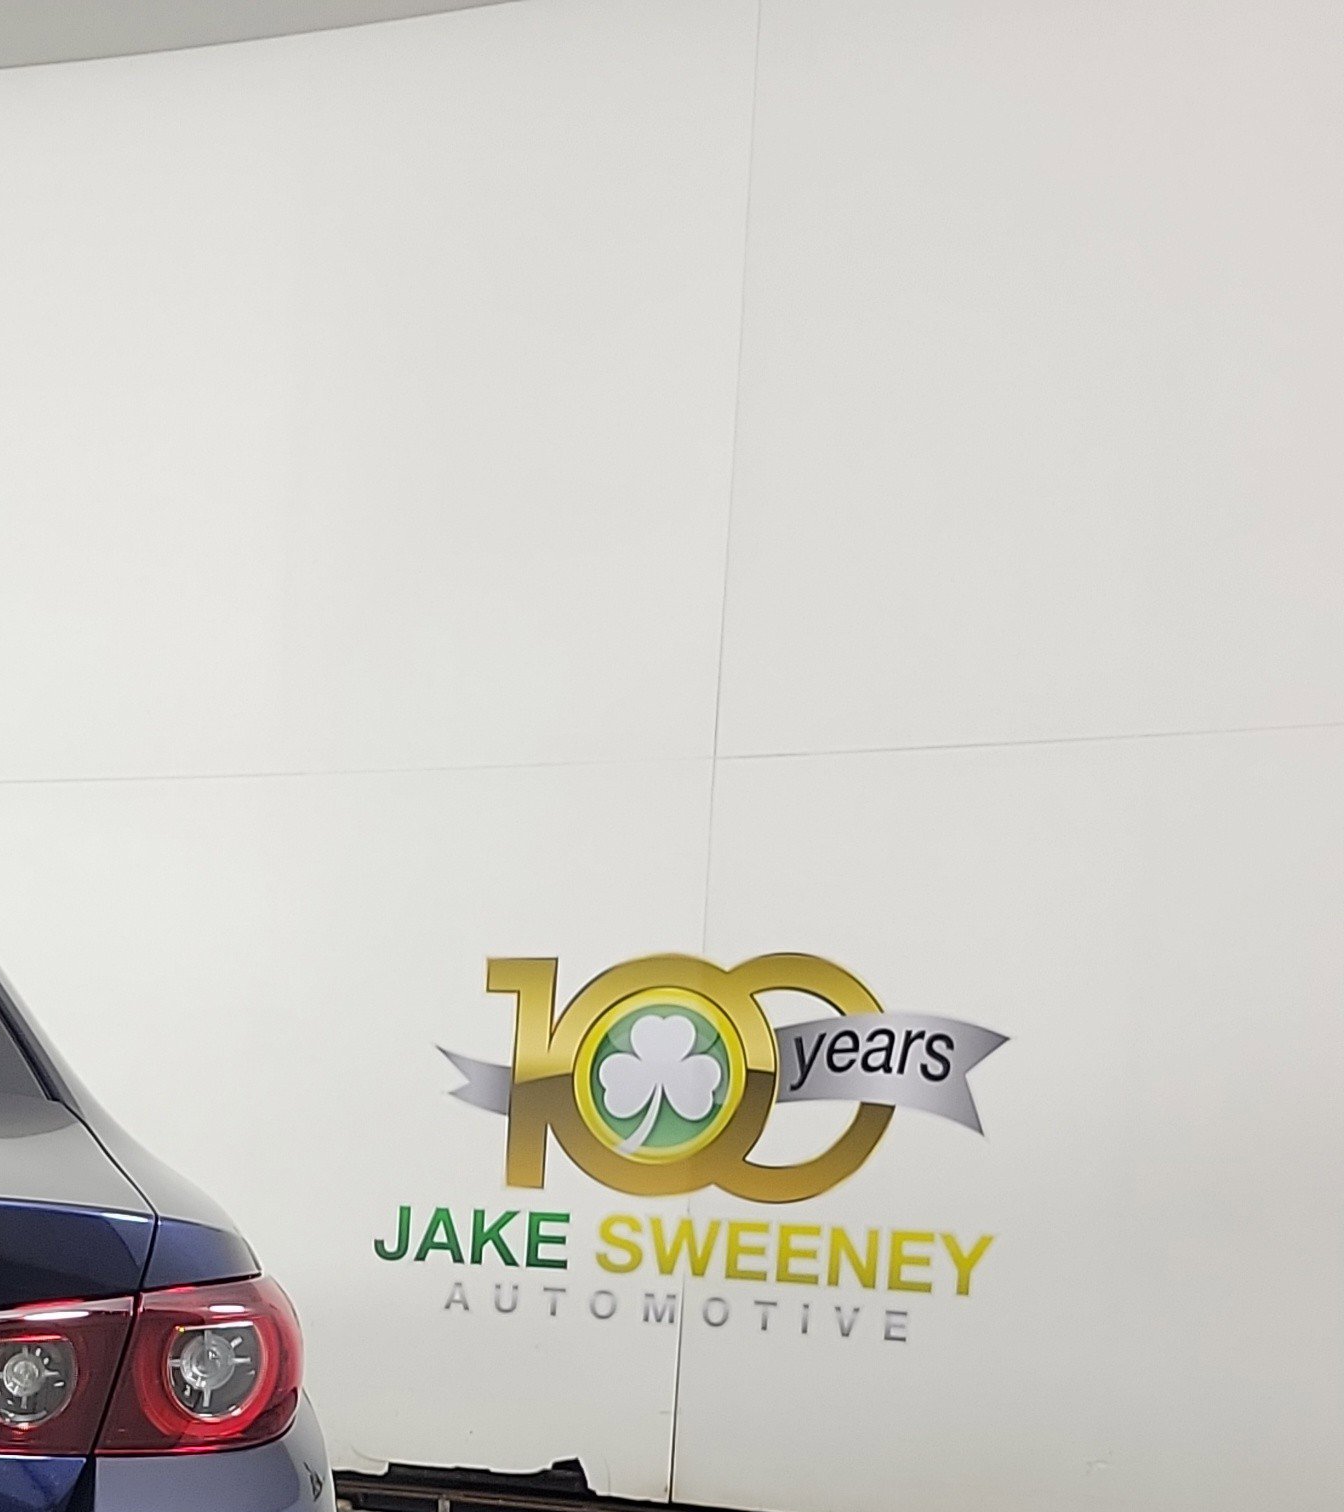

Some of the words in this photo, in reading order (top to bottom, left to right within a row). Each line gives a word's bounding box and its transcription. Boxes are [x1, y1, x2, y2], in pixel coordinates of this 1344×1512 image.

[485, 952, 896, 1204] 100
[788, 1027, 955, 1092] years
[374, 1205, 571, 1270] JAKE
[595, 1213, 994, 1297] SWEENEY
[444, 1281, 909, 1342] AUTOMOTIVE
